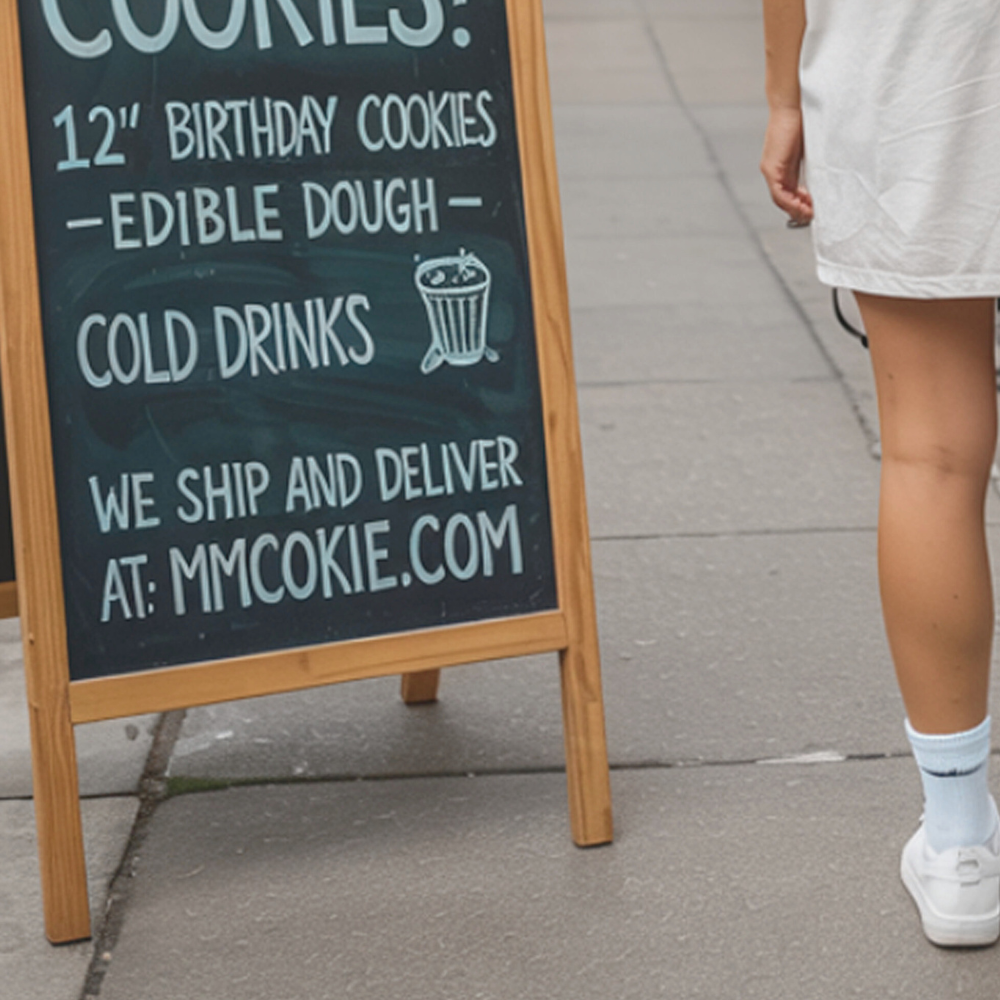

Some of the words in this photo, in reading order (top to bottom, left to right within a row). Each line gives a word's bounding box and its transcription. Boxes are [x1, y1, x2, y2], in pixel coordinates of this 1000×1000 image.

[53, 102, 140, 171] 12"
[164, 95, 338, 161] BIRTHDAY
[357, 89, 498, 152] COOKIES
[77, 309, 199, 388] COLD
[213, 293, 375, 379] DRINKS
[88, 472, 161, 533] WE
[176, 461, 270, 523] SHIP
[285, 452, 363, 513] AND
[374, 435, 524, 502] DELIVER
[100, 554, 157, 622] AT:
[169, 503, 524, 617] MMCOKIE.COM
